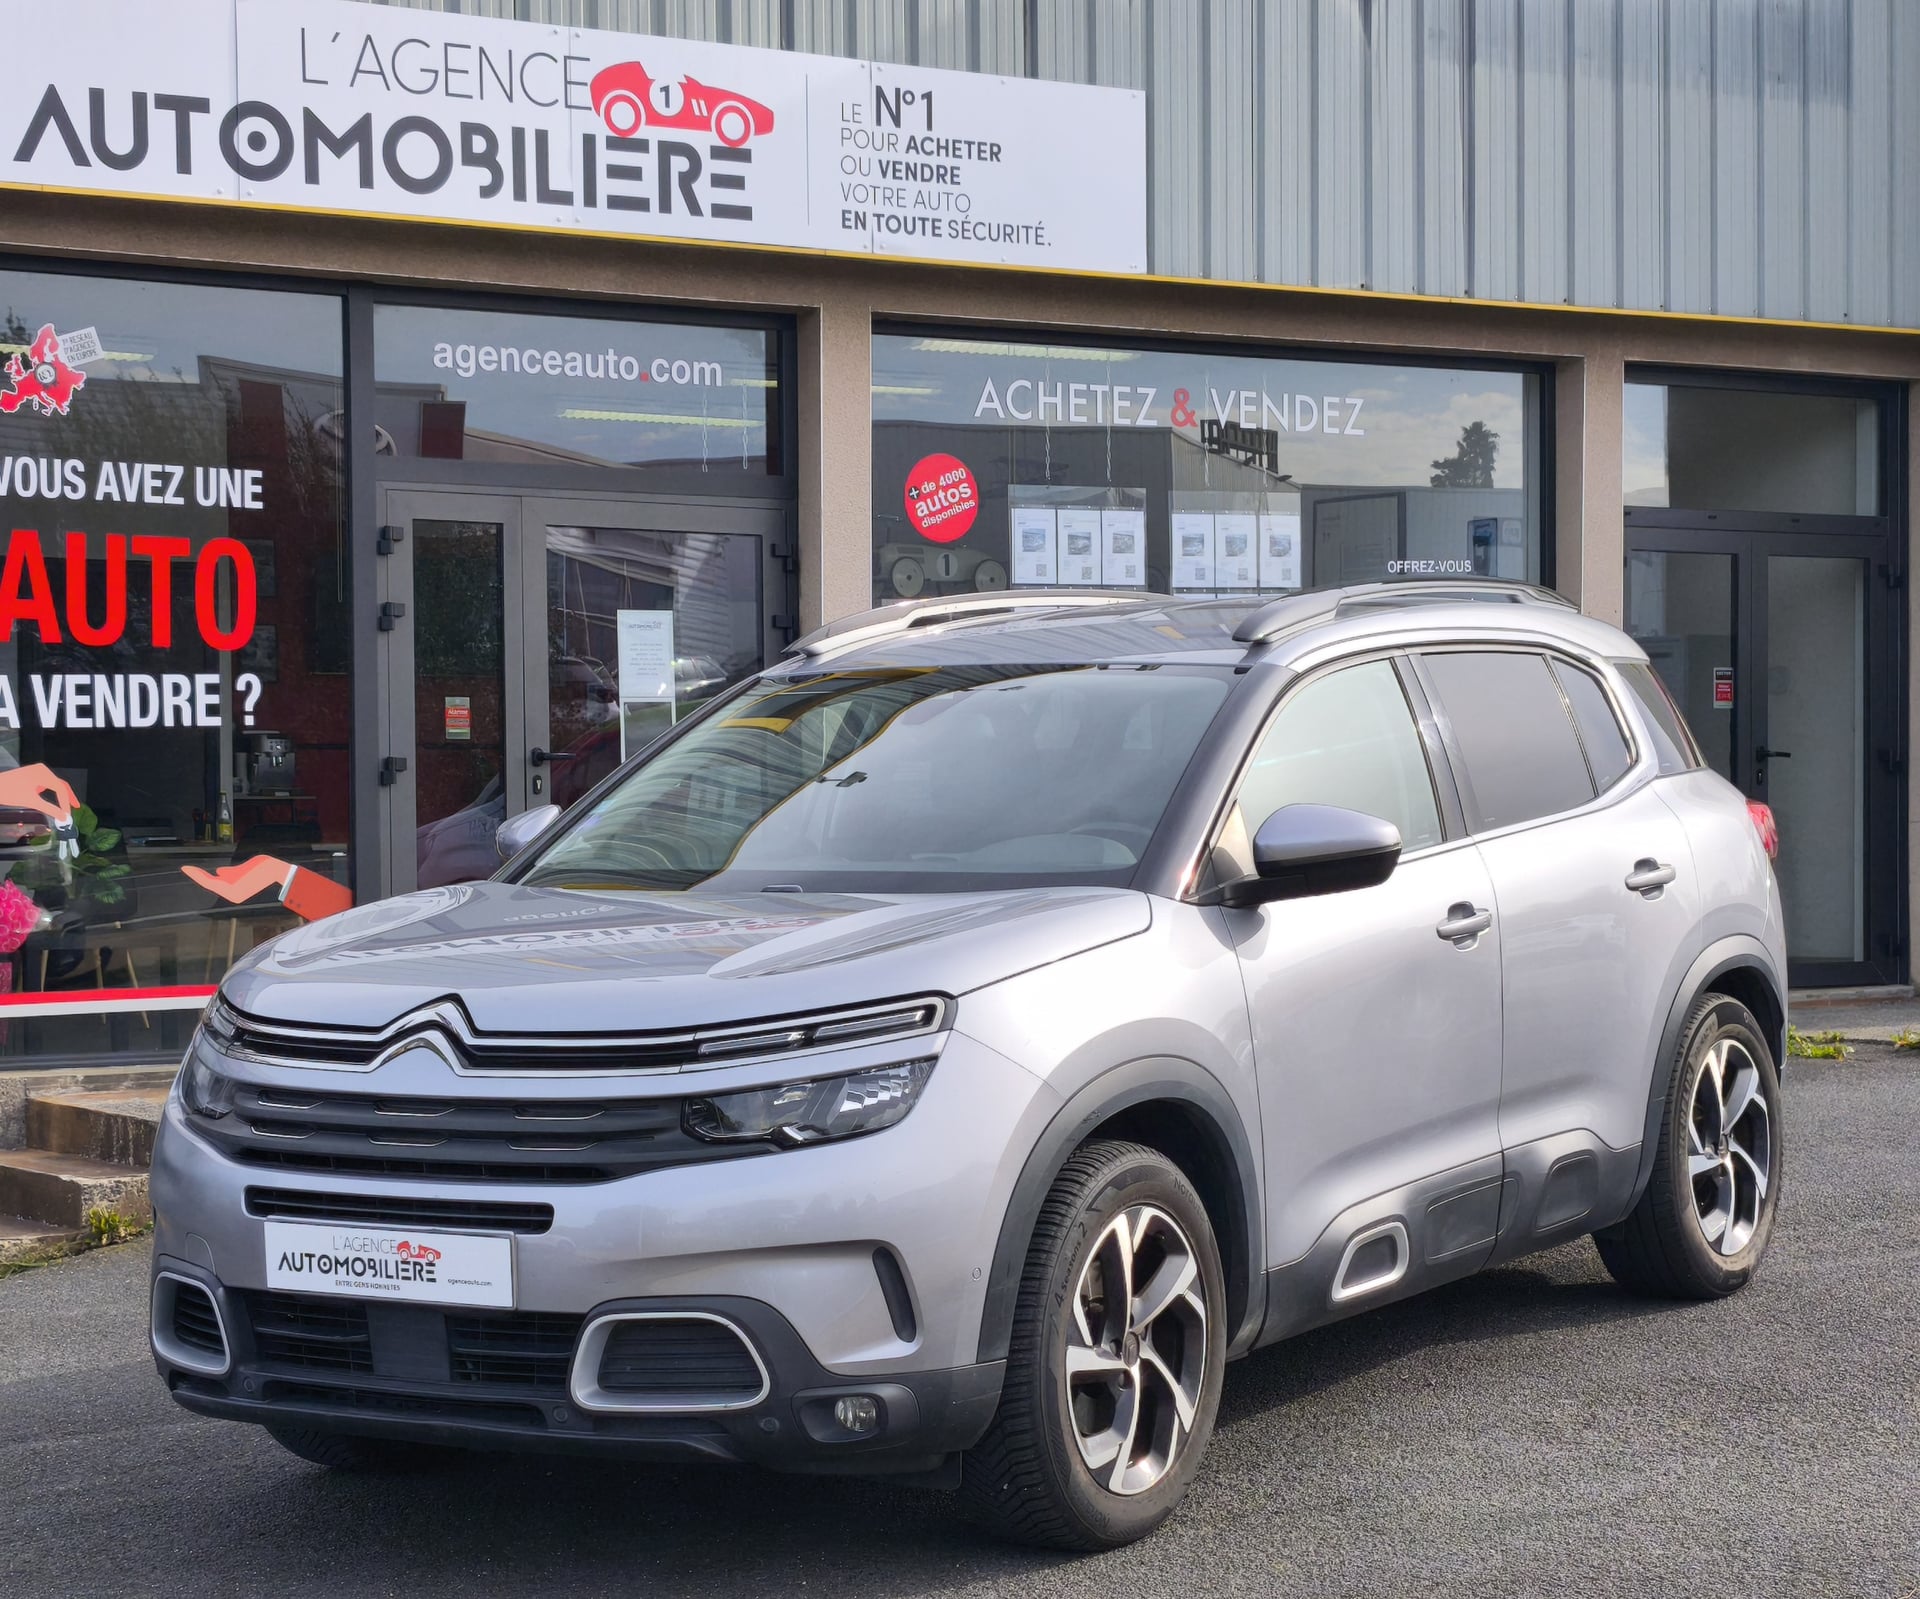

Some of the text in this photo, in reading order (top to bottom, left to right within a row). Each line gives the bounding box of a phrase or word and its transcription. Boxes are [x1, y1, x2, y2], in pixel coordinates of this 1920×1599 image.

[300, 27, 592, 112] L'AGENCE
[841, 102, 863, 124] LE
[841, 127, 1002, 162] POUR ACHETER
[840, 155, 961, 185] OU VENDRE
[840, 182, 971, 213] VOTRE AUTO
[841, 209, 1052, 247] EN TOUTE SÉCURITÉ.
[433, 342, 722, 387] agenceauto.com
[974, 377, 1365, 436] ACHETEZ & VENDEZ
[0, 456, 264, 509] VOUS AVEZ UNE
[921, 481, 937, 494] de
[939, 467, 967, 487] 4000
[915, 482, 972, 517] autos
[921, 499, 976, 528] disponibles
[1387, 559, 1472, 574] OFFREZ-VOUS
[0, 528, 257, 652] AUTO
[30, 673, 222, 729] VENDRE
[235, 672, 262, 727] ?
[332, 1235, 399, 1255] L'AGENCE
[278, 1251, 437, 1284] AUTOMOBILIERE
